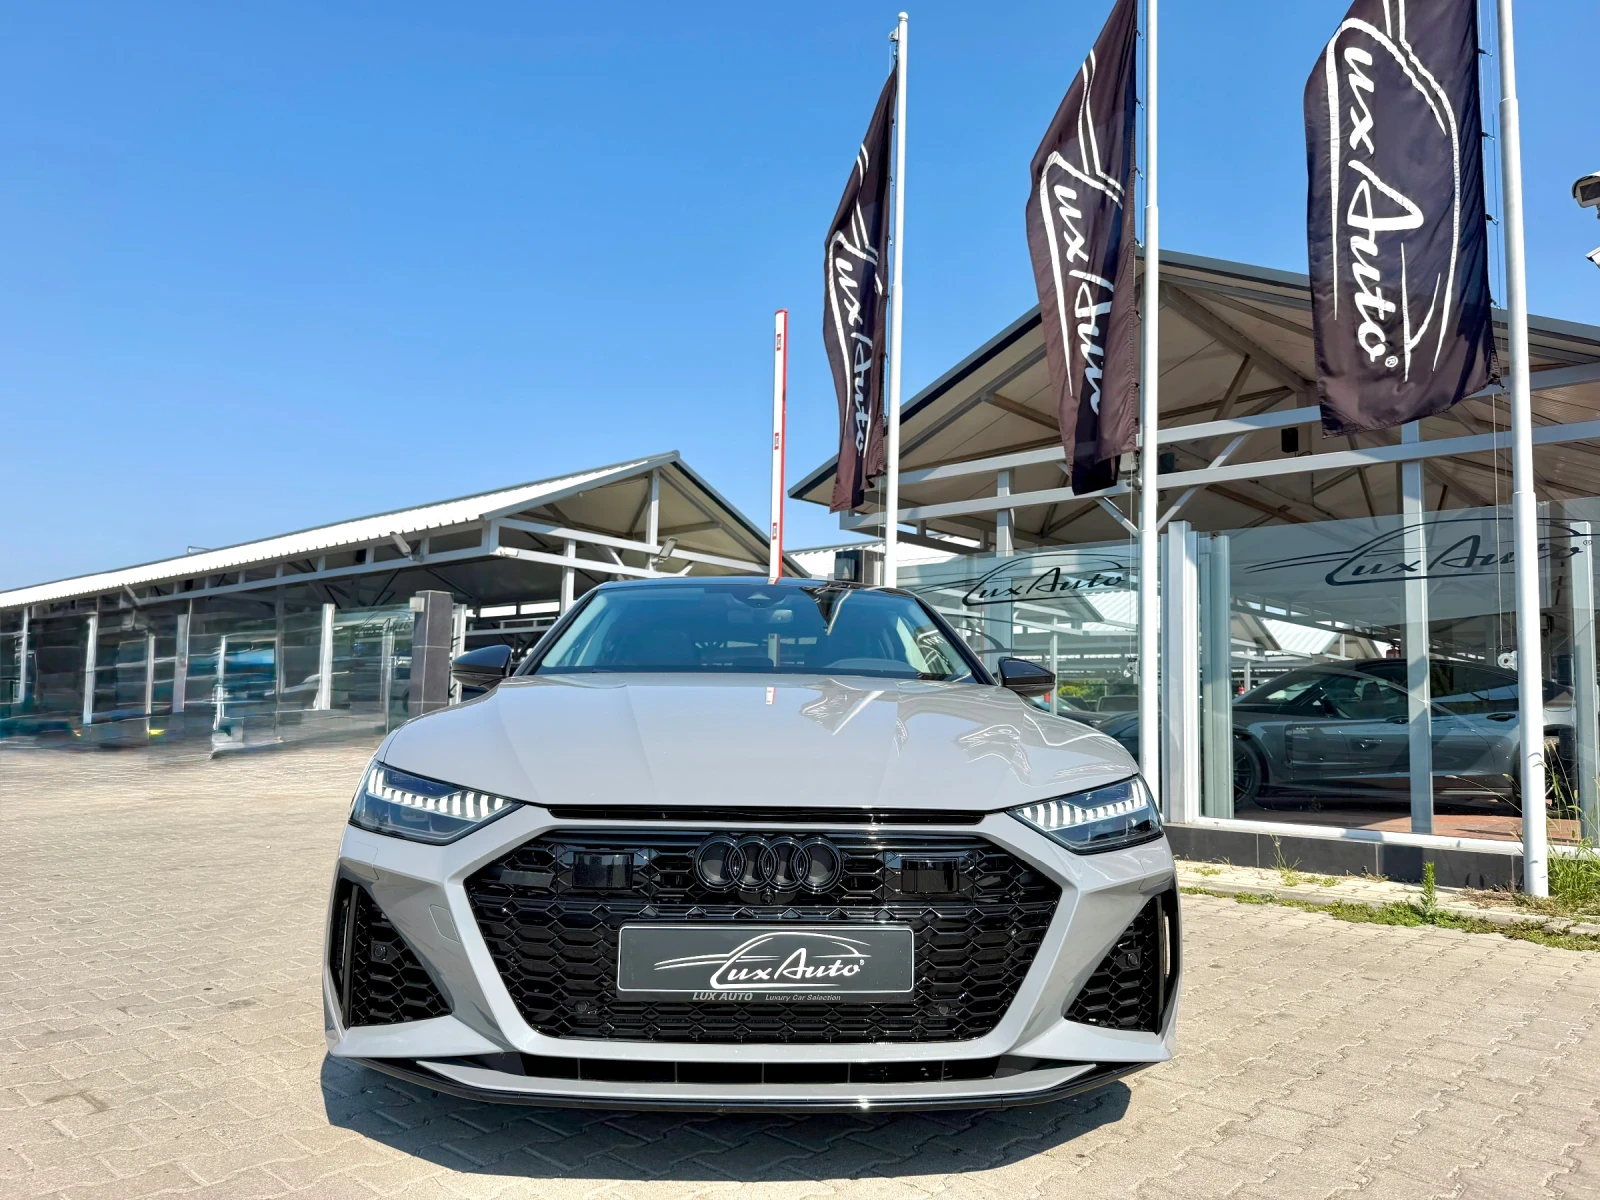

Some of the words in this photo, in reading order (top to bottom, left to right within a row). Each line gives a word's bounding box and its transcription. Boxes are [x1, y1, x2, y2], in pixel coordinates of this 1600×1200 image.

[1427, 534, 1584, 571] Auo
[692, 992, 717, 1001] LUX
[718, 992, 753, 1001] AUTO
[765, 994, 792, 1002] Luxury
